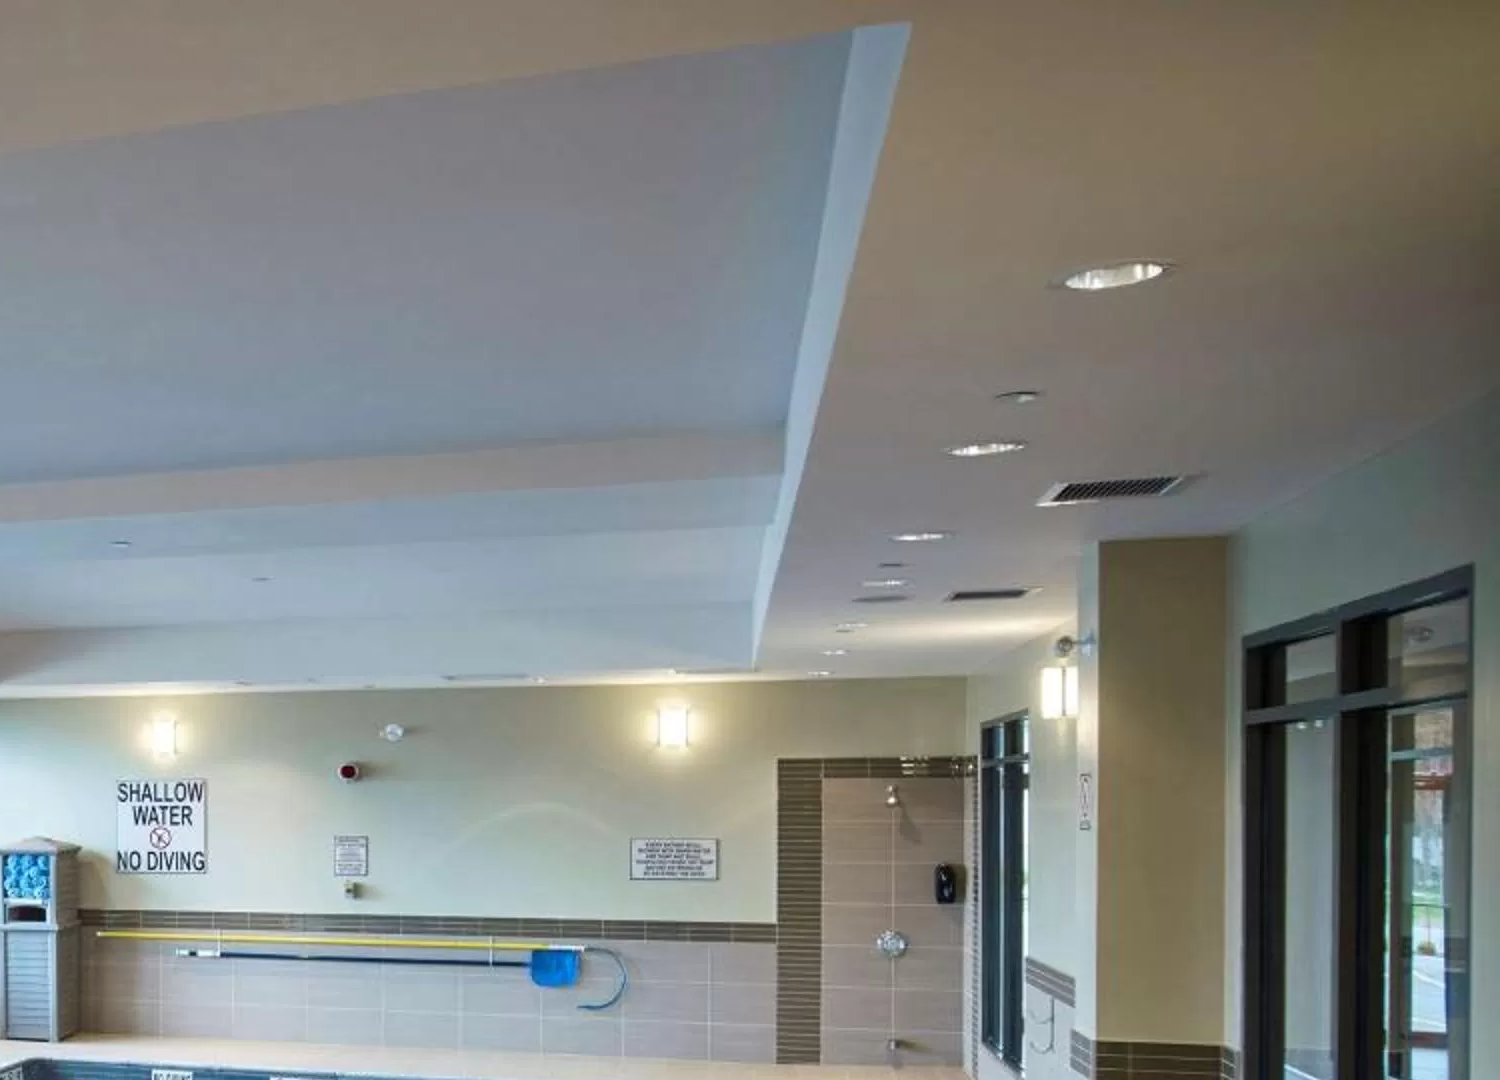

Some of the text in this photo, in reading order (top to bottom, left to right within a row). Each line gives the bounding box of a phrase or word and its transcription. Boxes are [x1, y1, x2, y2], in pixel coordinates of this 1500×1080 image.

[117, 782, 203, 802] SHALLOW
[133, 805, 193, 826] WATER
[117, 850, 205, 871] NO DIVING
